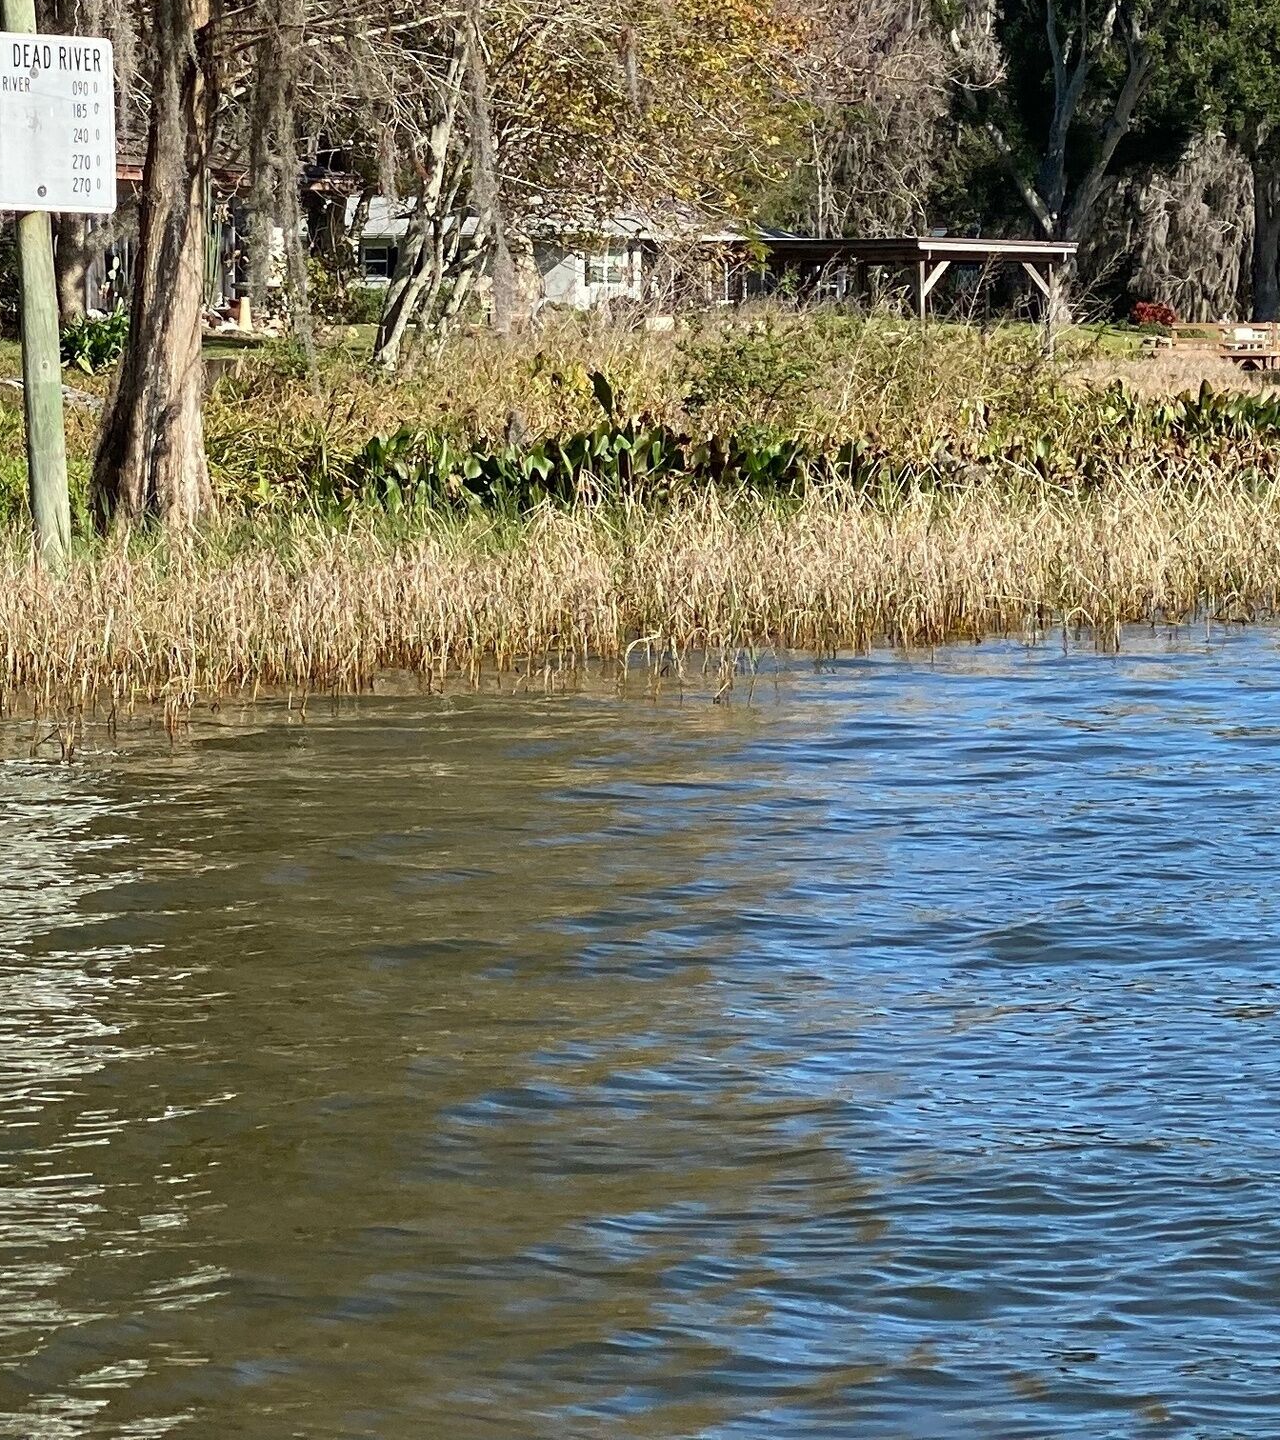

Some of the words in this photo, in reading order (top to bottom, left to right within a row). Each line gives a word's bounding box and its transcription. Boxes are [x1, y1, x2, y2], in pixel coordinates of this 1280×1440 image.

[13, 43, 52, 69] DEAD
[59, 46, 101, 72] RIVER
[2, 76, 31, 93] RIVER
[72, 80, 89, 96] 090
[73, 103, 88, 119] 185
[73, 127, 89, 143] 240
[72, 154, 91, 170] 270
[72, 177, 91, 193] 270
